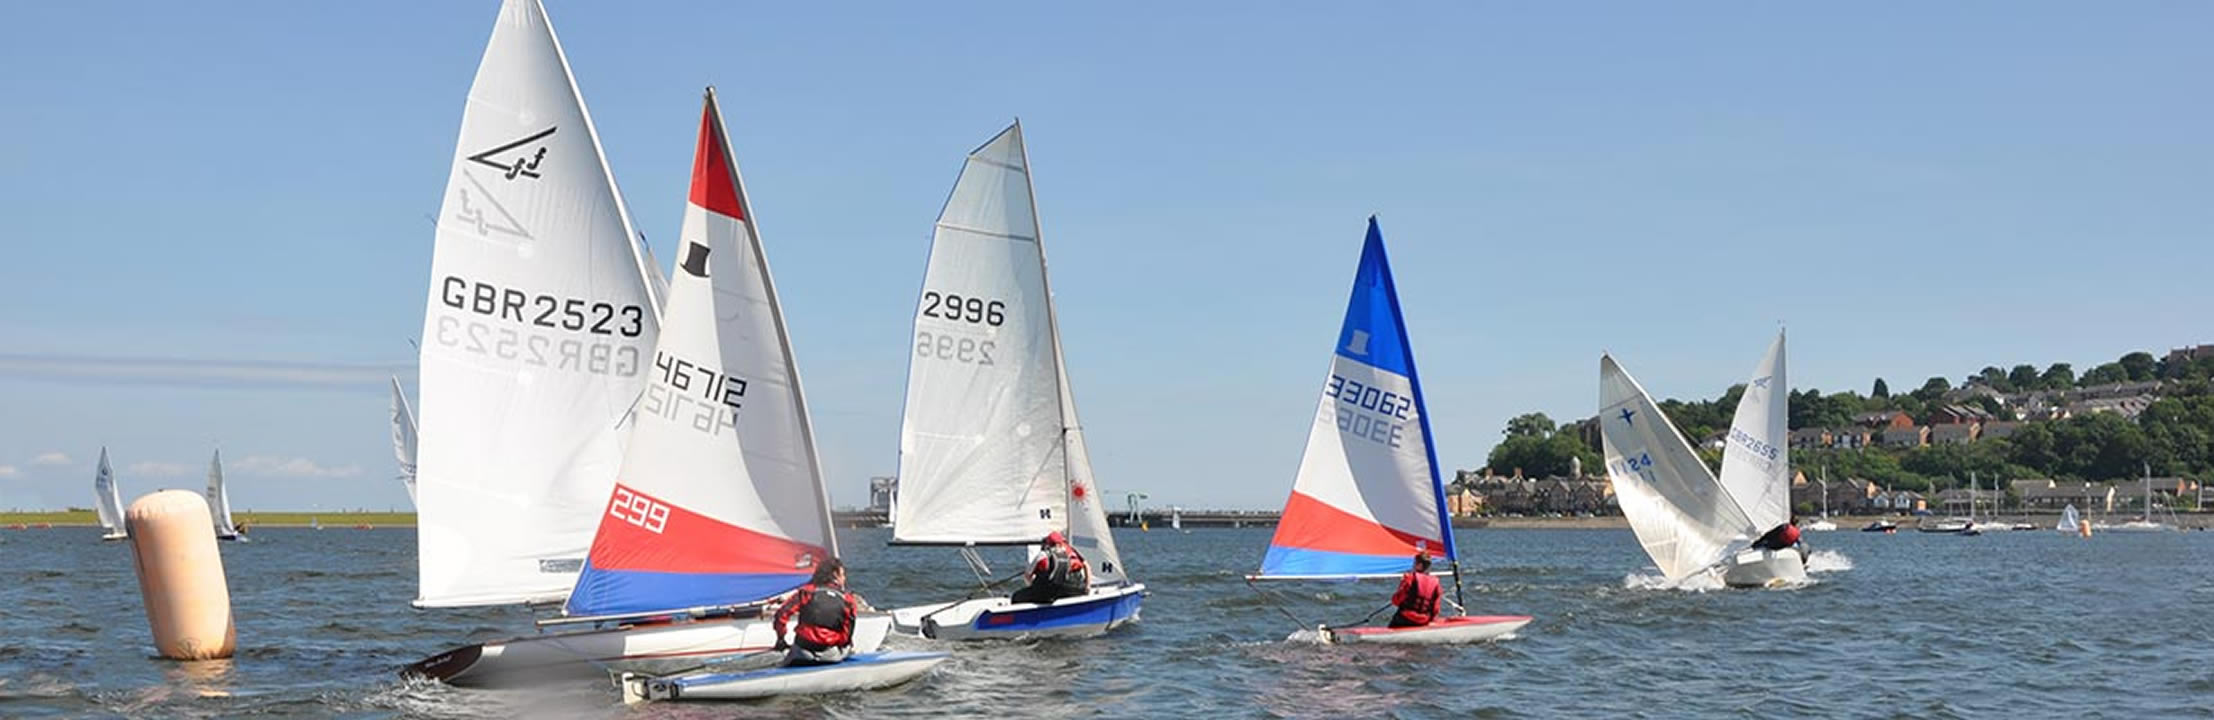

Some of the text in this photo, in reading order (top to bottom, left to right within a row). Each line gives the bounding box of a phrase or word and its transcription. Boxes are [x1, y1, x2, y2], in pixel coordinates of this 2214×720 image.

[442, 276, 644, 338] GBR2523
[923, 291, 1005, 327] 2996
[656, 351, 747, 408] 46712
[1325, 374, 1411, 420] 33062
[610, 488, 671, 535] 299
